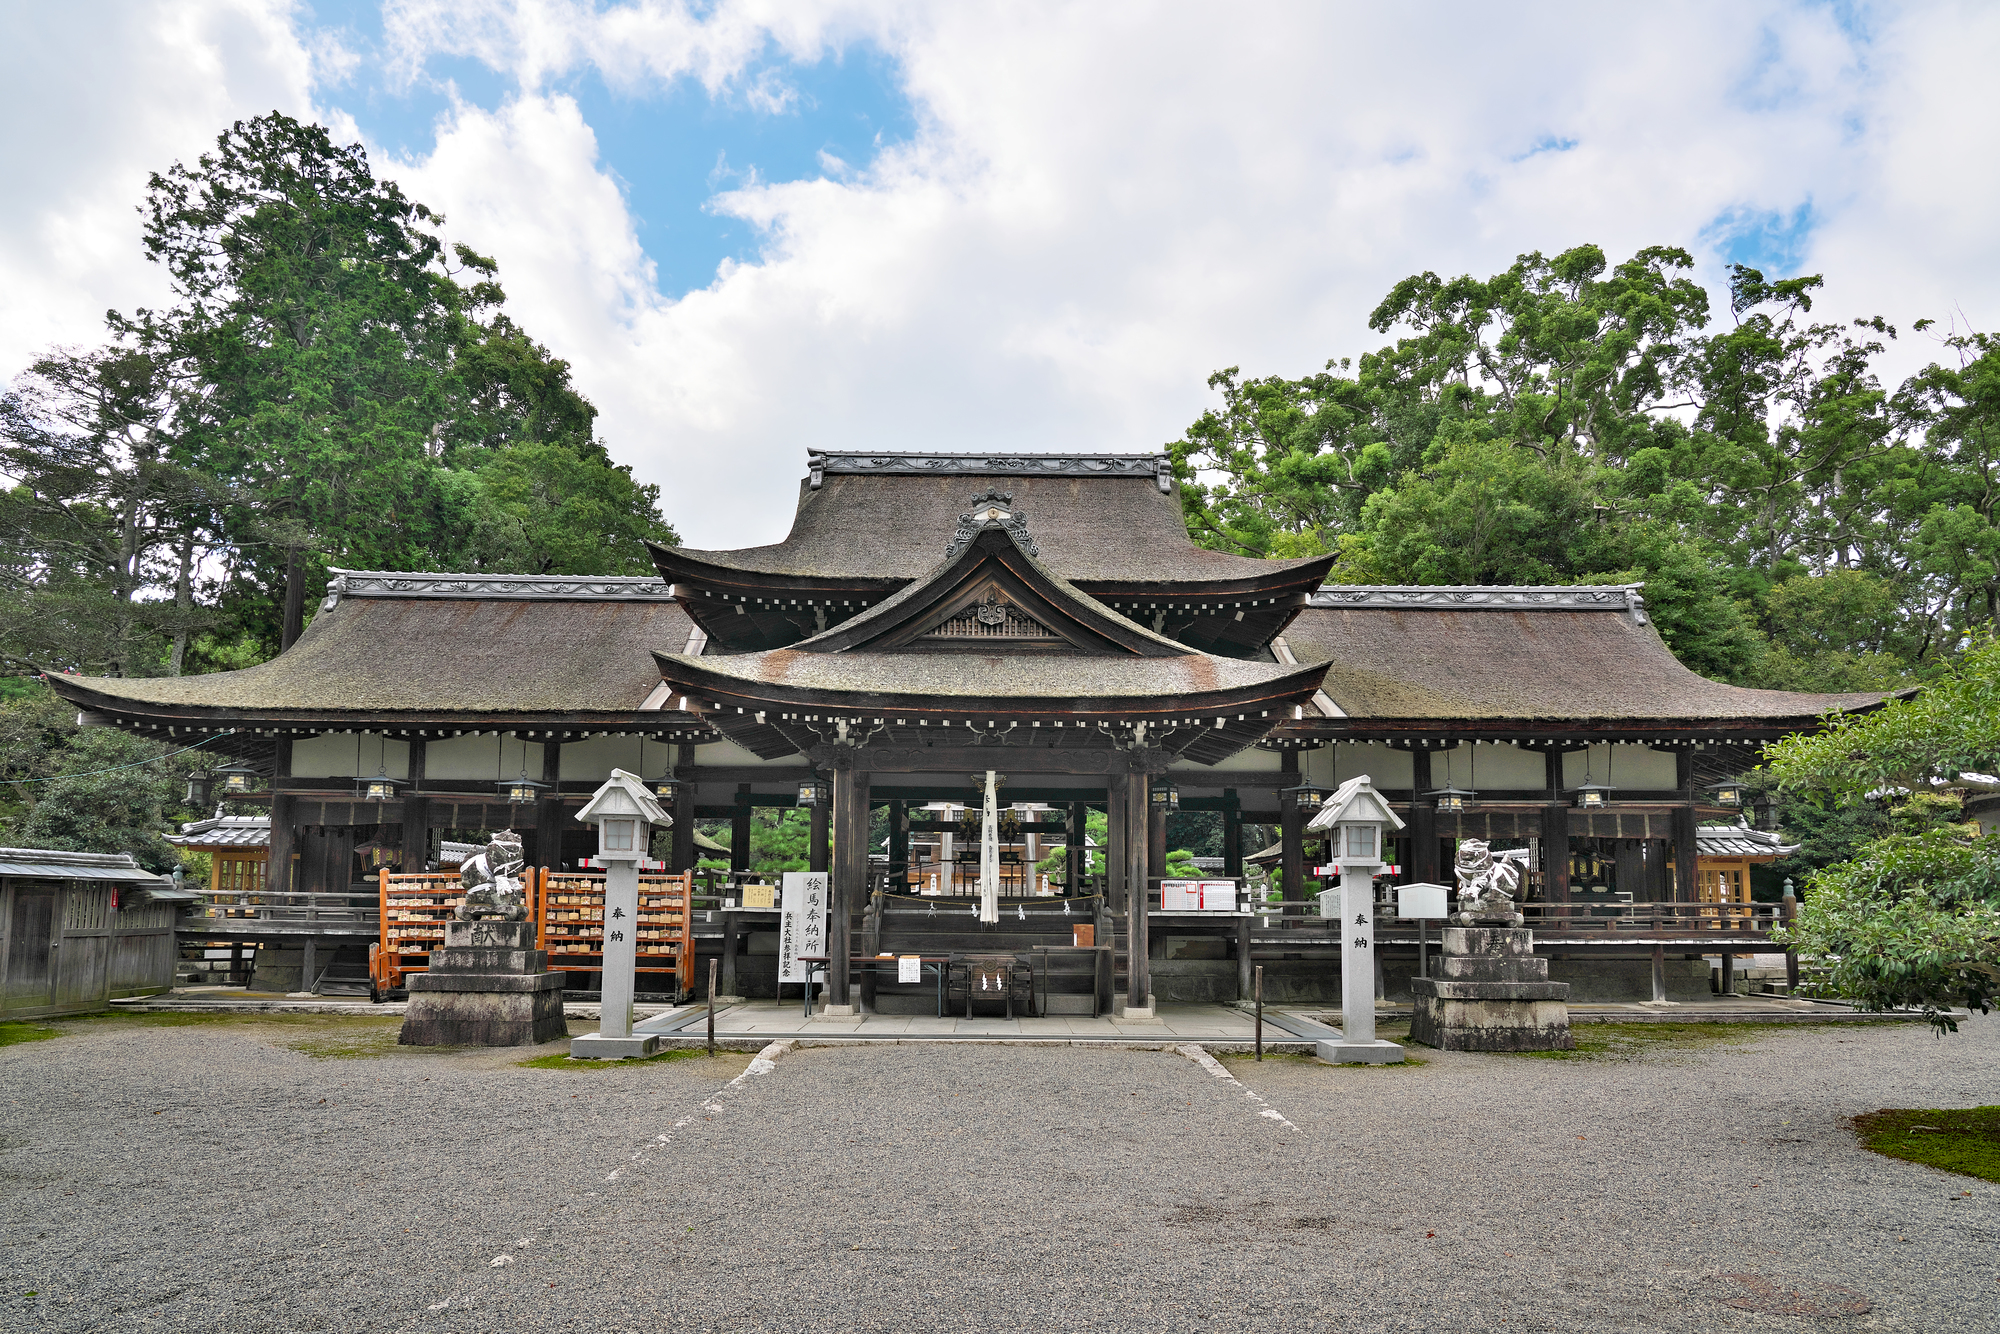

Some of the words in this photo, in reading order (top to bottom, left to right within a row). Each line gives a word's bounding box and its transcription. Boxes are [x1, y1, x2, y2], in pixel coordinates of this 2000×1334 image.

[610, 906, 626, 942] 奉納
[805, 878, 822, 953] 絵馬奉納所
[1354, 913, 1368, 949] 奉納
